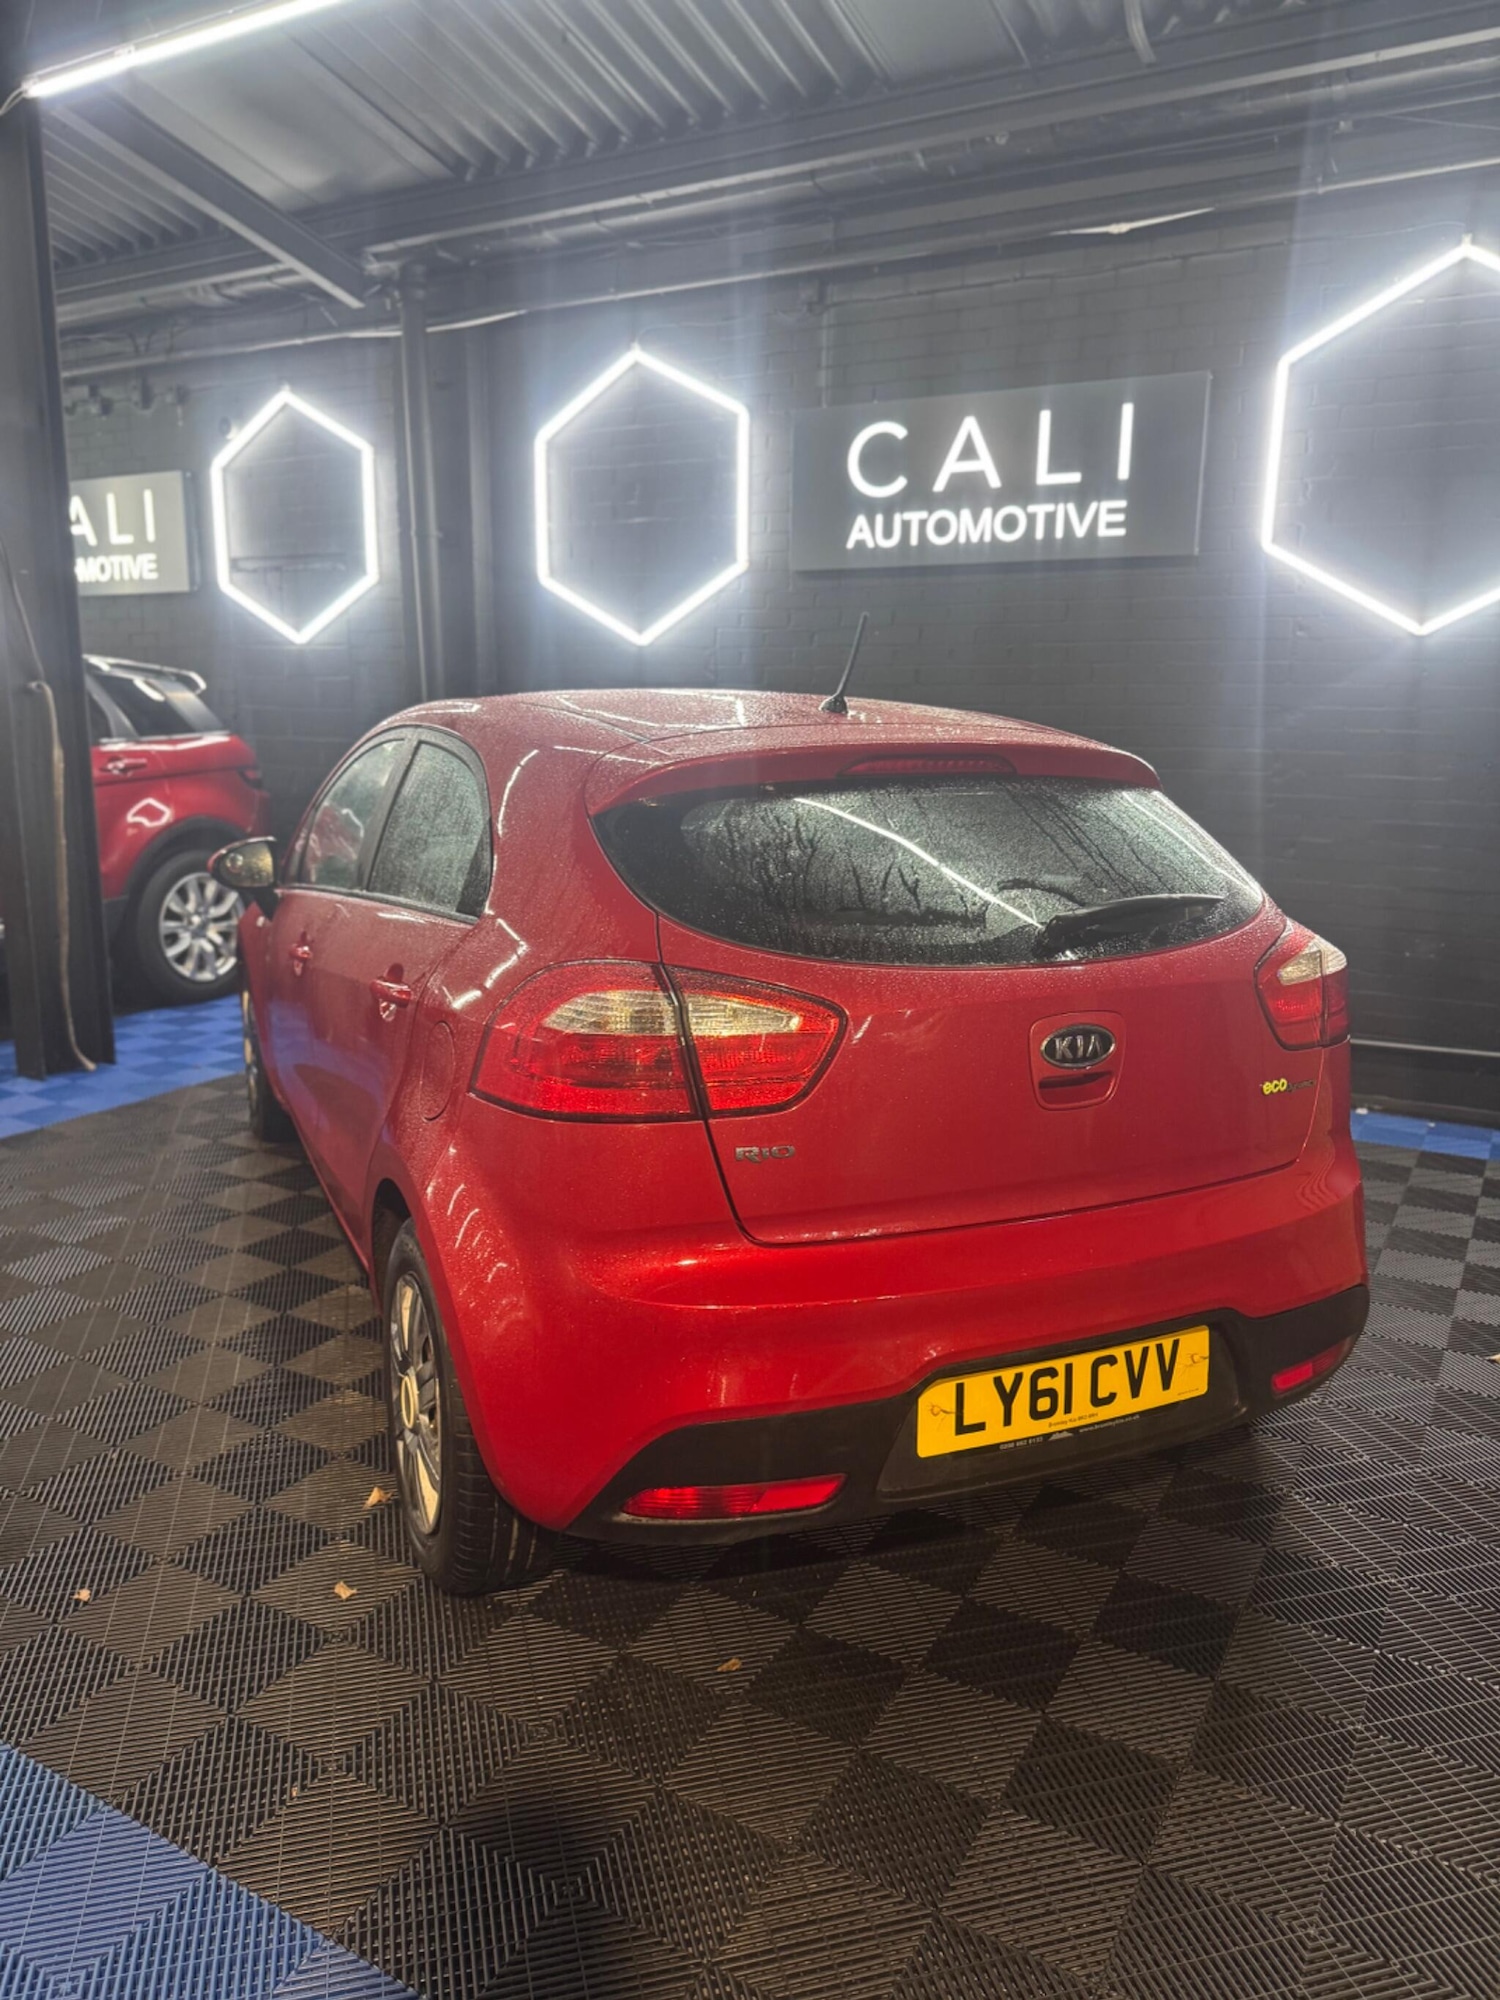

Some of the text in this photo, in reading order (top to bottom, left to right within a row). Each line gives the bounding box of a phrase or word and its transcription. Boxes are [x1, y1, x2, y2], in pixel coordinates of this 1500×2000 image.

[847, 402, 1134, 498] CALI
[69, 488, 156, 547] ALI
[846, 500, 1127, 549] AUTOMOTIVE
[74, 553, 159, 583] MOTIVE
[1054, 1034, 1104, 1060] KIA
[735, 1145, 796, 1164] RIO
[954, 1339, 1180, 1437] LY61 CVV
